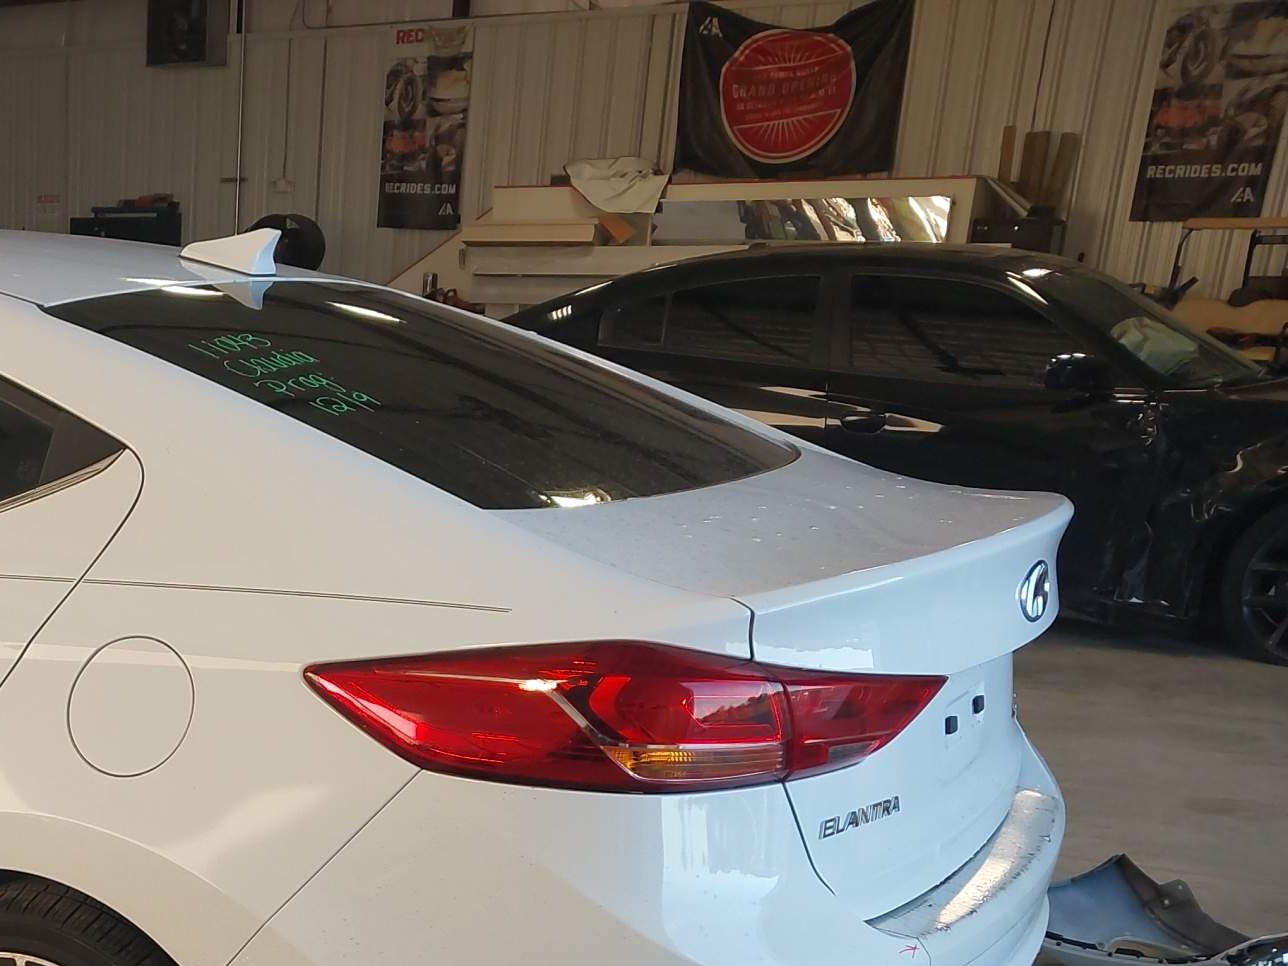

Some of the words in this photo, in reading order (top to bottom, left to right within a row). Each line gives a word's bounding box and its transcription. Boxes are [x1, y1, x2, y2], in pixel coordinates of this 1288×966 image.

[1146, 163, 1261, 178] RECRIDES.COM
[385, 182, 456, 194] RECRIDES.COM
[188, 333, 272, 359] 11043
[309, 391, 382, 416] 12/9
[818, 796, 901, 840] ELANTRA
